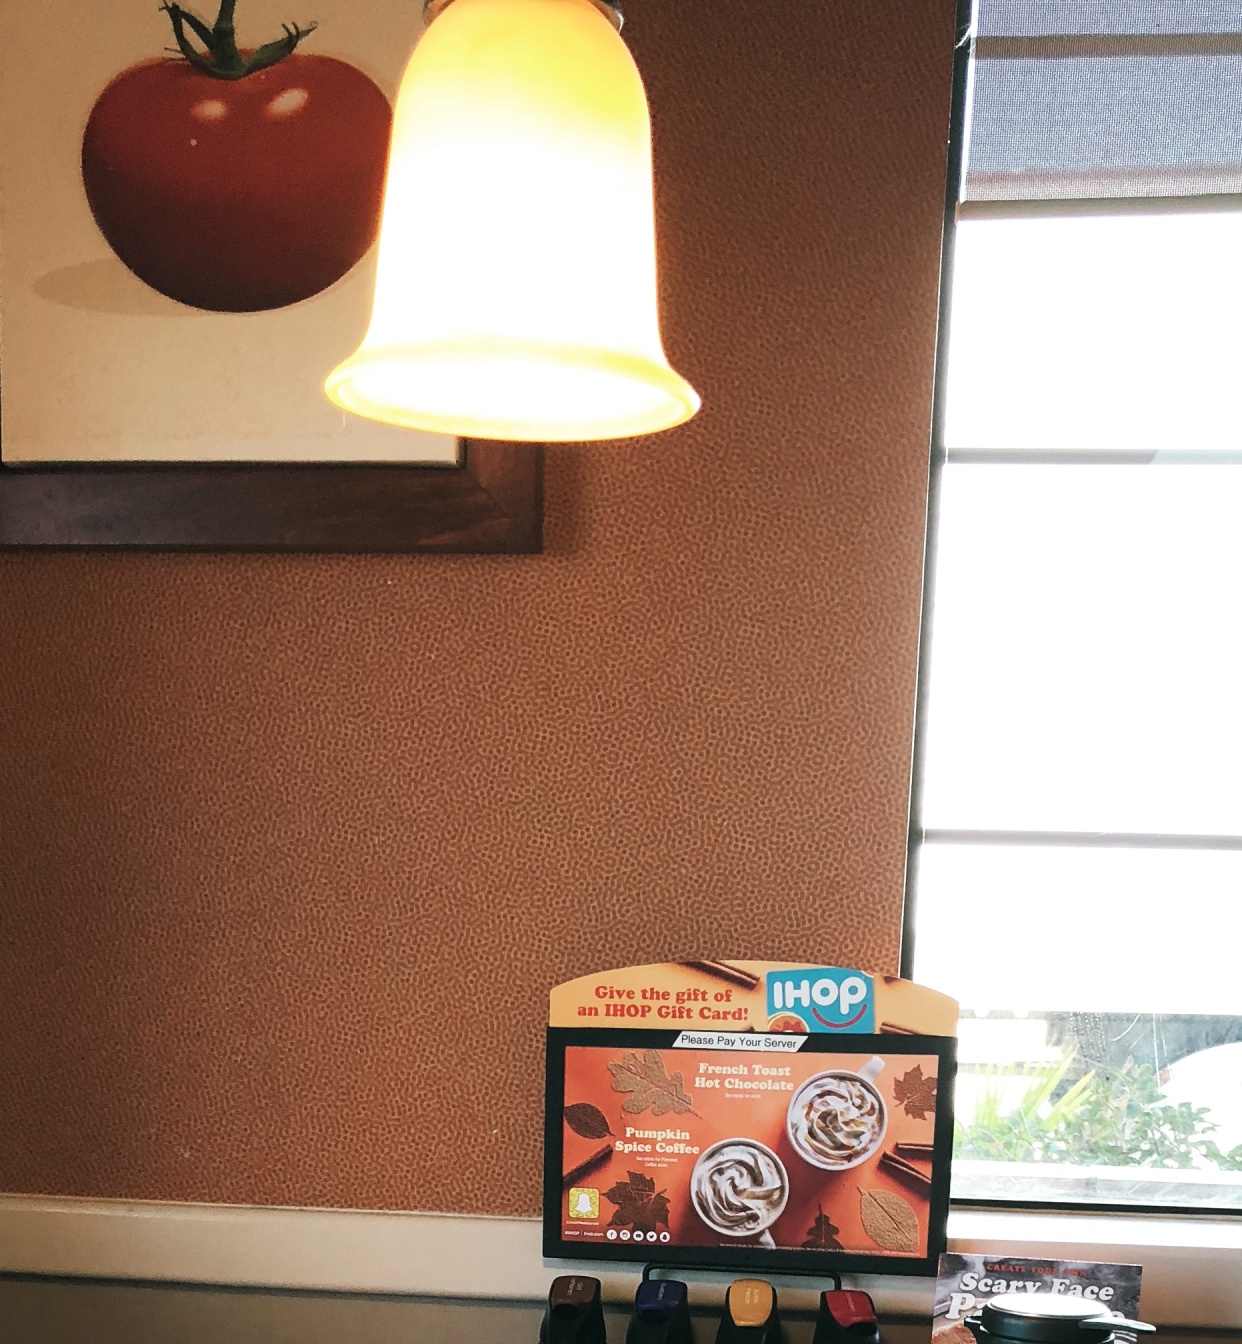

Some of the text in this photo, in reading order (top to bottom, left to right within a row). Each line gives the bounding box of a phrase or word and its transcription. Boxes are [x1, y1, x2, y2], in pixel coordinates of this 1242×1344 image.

[594, 985, 733, 1005] Give the gift of
[577, 1004, 748, 1021] an IHOP Gift Card!
[681, 1034, 797, 1048] Please Pay Your Server
[699, 1062, 791, 1076] French Toast
[694, 1077, 794, 1091] Hot Chocolate
[625, 1127, 690, 1141] Pumpkin
[615, 1140, 700, 1155] Spice Coffee
[987, 1263, 1026, 1273] CREATE
[1030, 1266, 1058, 1275] YOUR
[959, 1272, 1114, 1301] Scary Face
